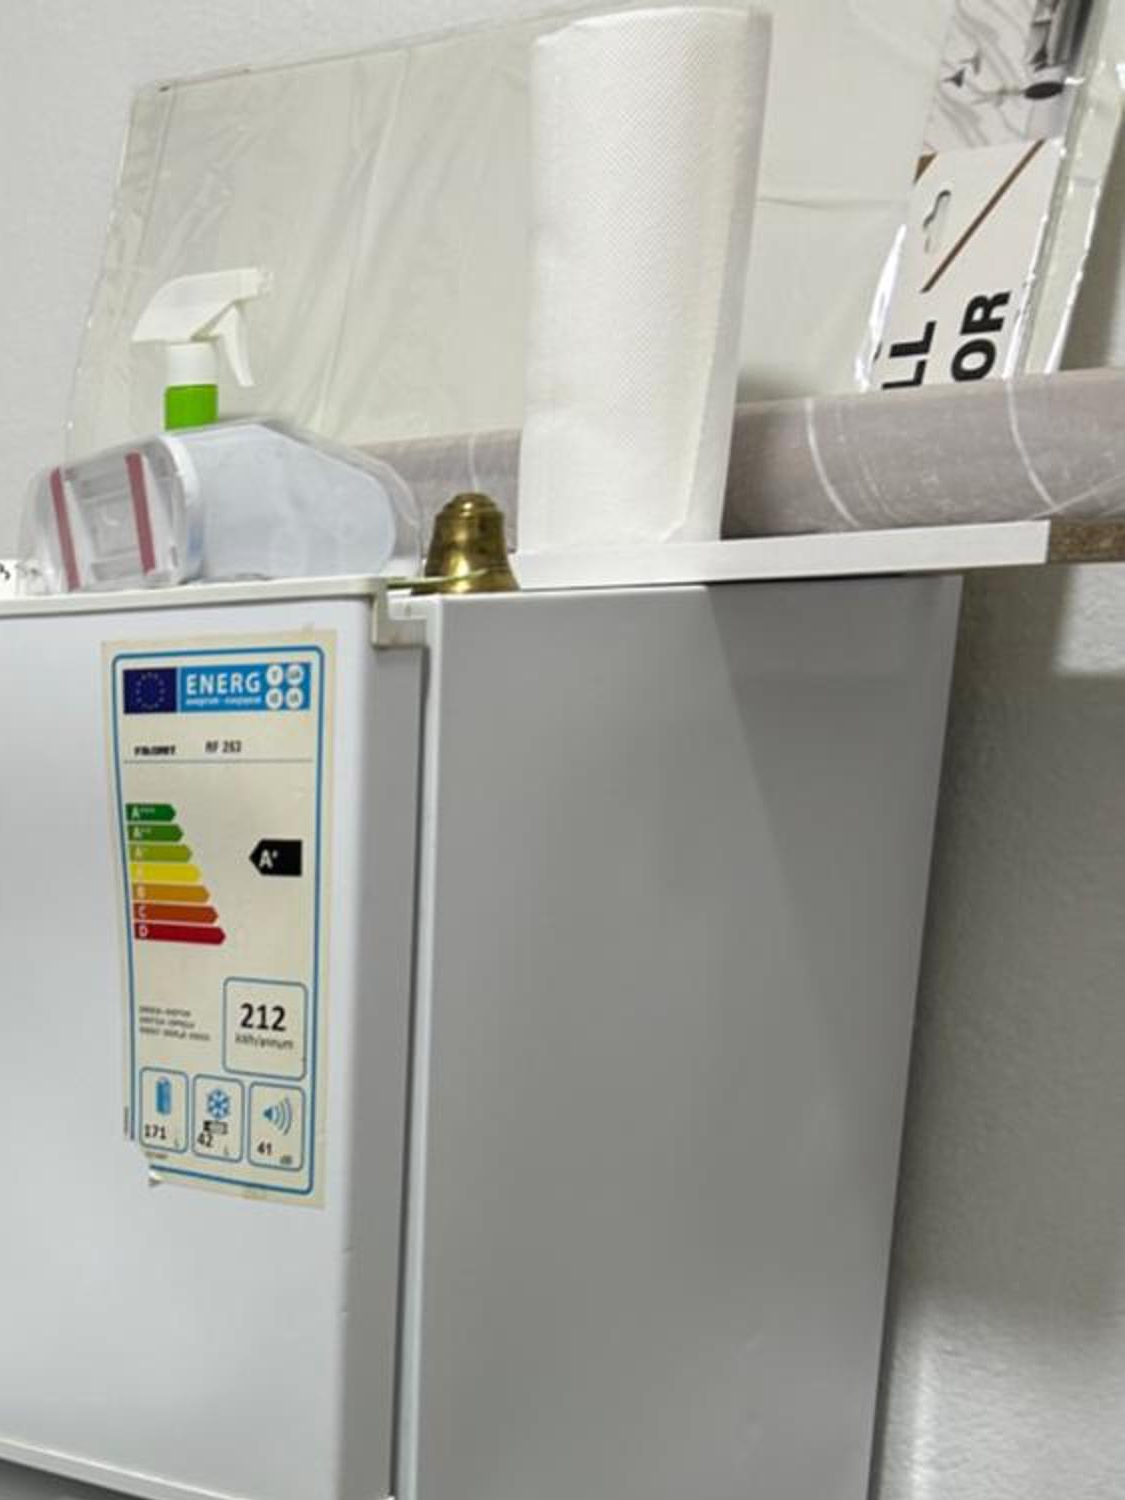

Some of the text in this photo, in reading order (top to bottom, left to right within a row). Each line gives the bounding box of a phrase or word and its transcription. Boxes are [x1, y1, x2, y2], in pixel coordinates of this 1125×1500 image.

[951, 291, 1011, 382] OR
[186, 672, 261, 695] ENERG
[258, 850, 277, 869] A+
[240, 1003, 286, 1032] 212
[145, 1124, 167, 1140] 171
[197, 1133, 214, 1148] 42
[257, 1142, 272, 1155] 41
